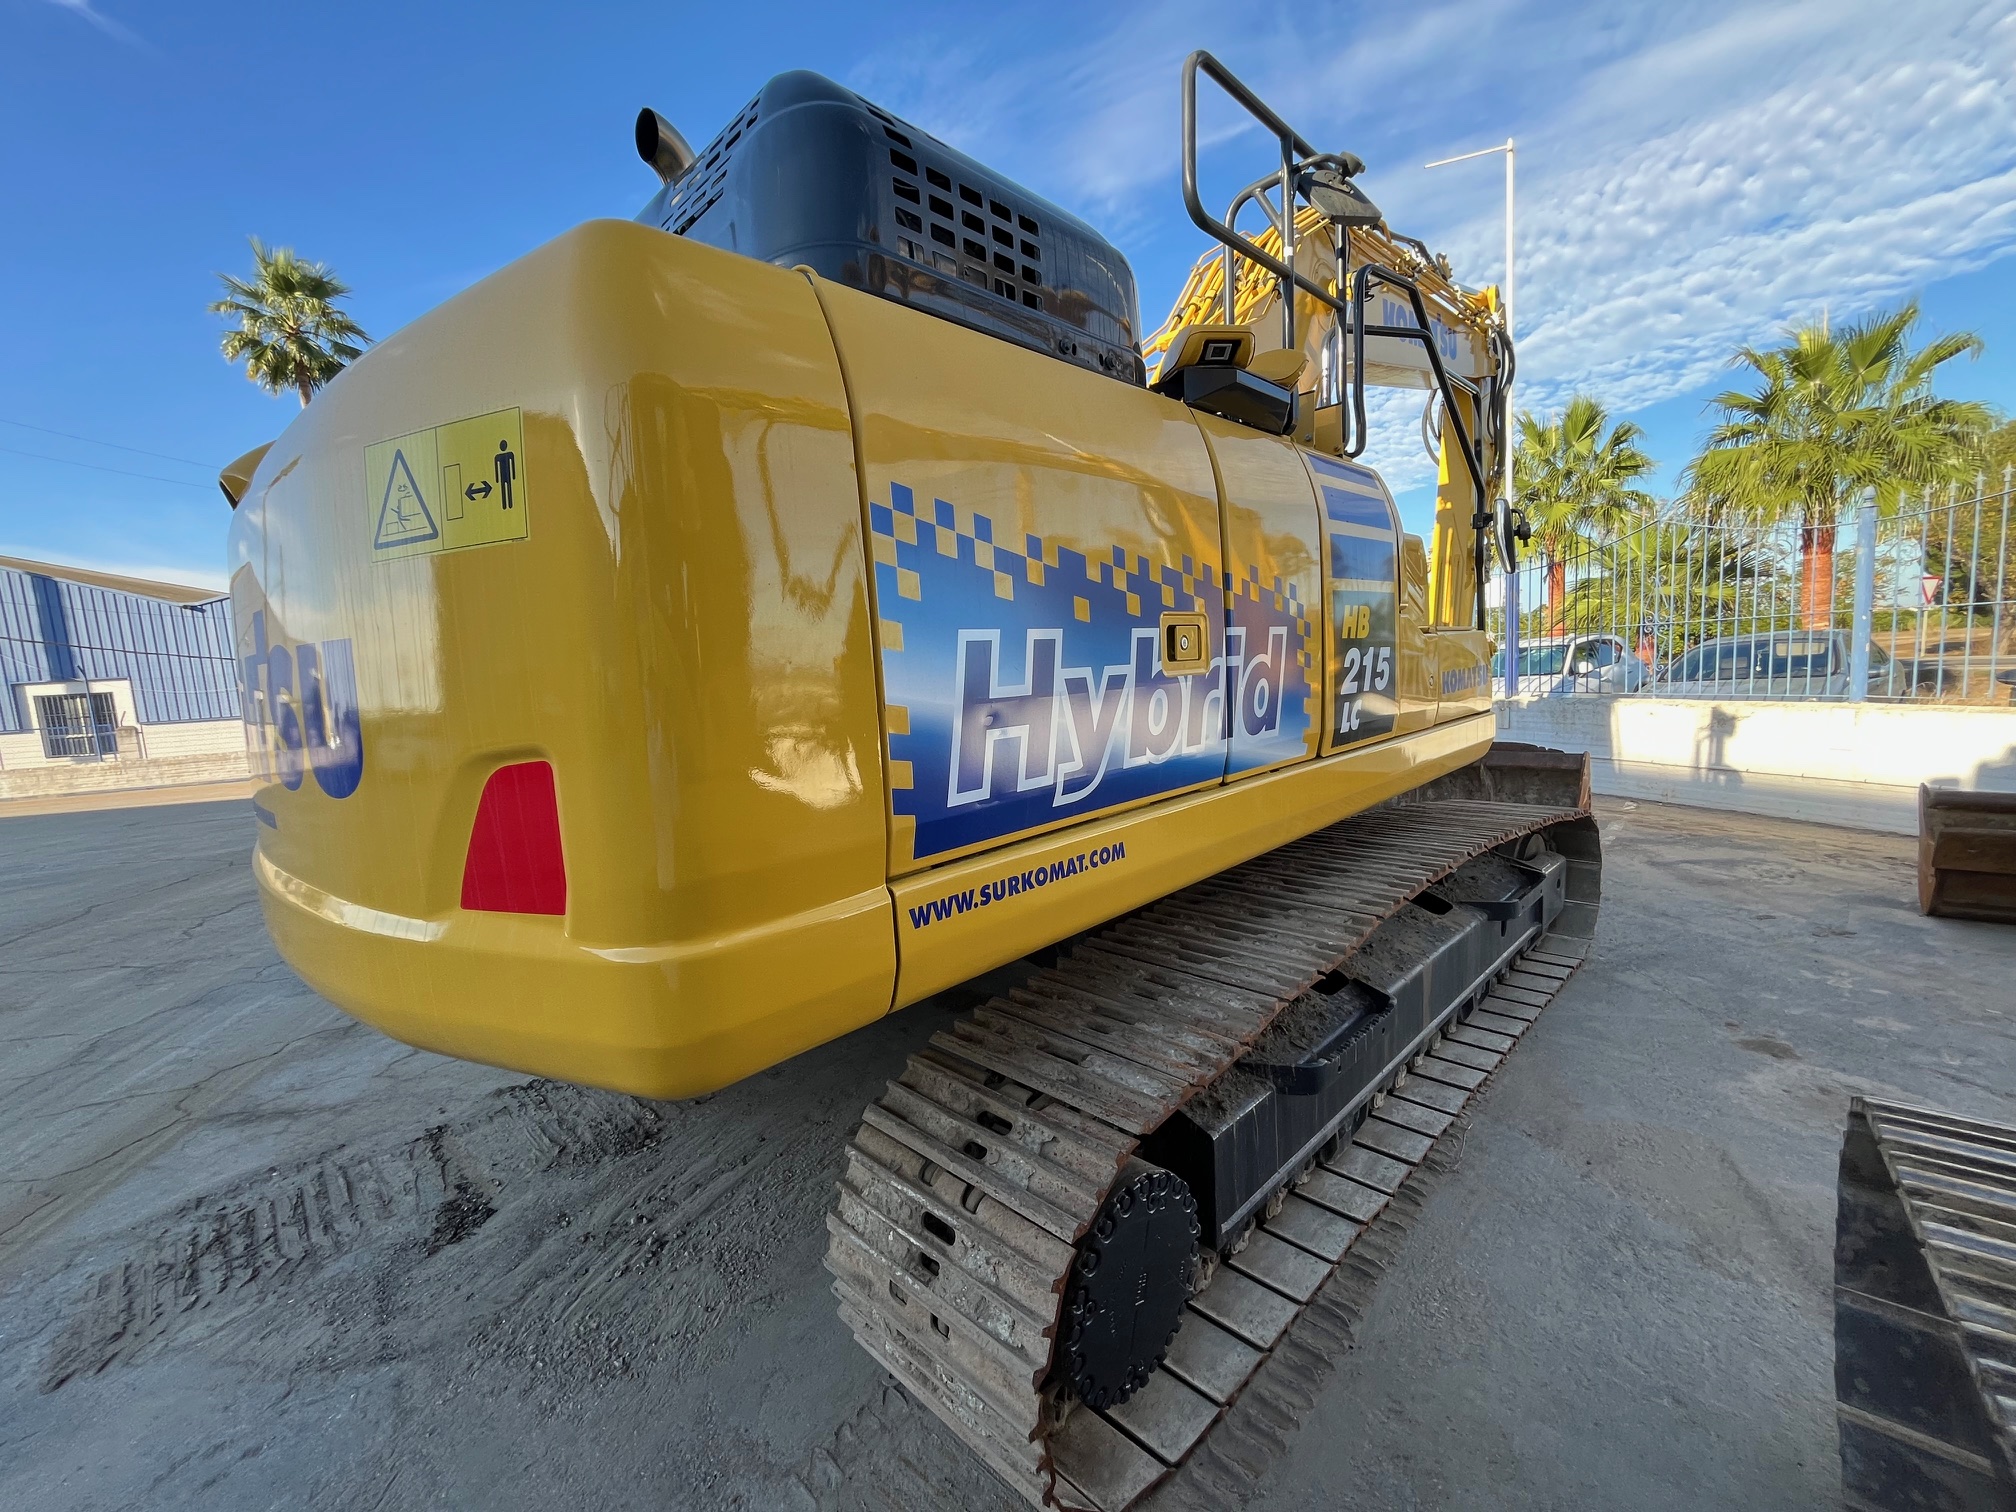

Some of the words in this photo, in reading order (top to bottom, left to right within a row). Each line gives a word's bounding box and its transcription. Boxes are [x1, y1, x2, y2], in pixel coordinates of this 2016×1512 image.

[1382, 298, 1457, 360] KOMTSU
[1341, 604, 1371, 639] HB
[1340, 646, 1391, 695] 215
[1441, 661, 1488, 695] KOMATSU
[946, 626, 1288, 807] Hybrid
[1339, 699, 1362, 734] LC
[908, 842, 1126, 929] WWW.SURKOMAT.COM
